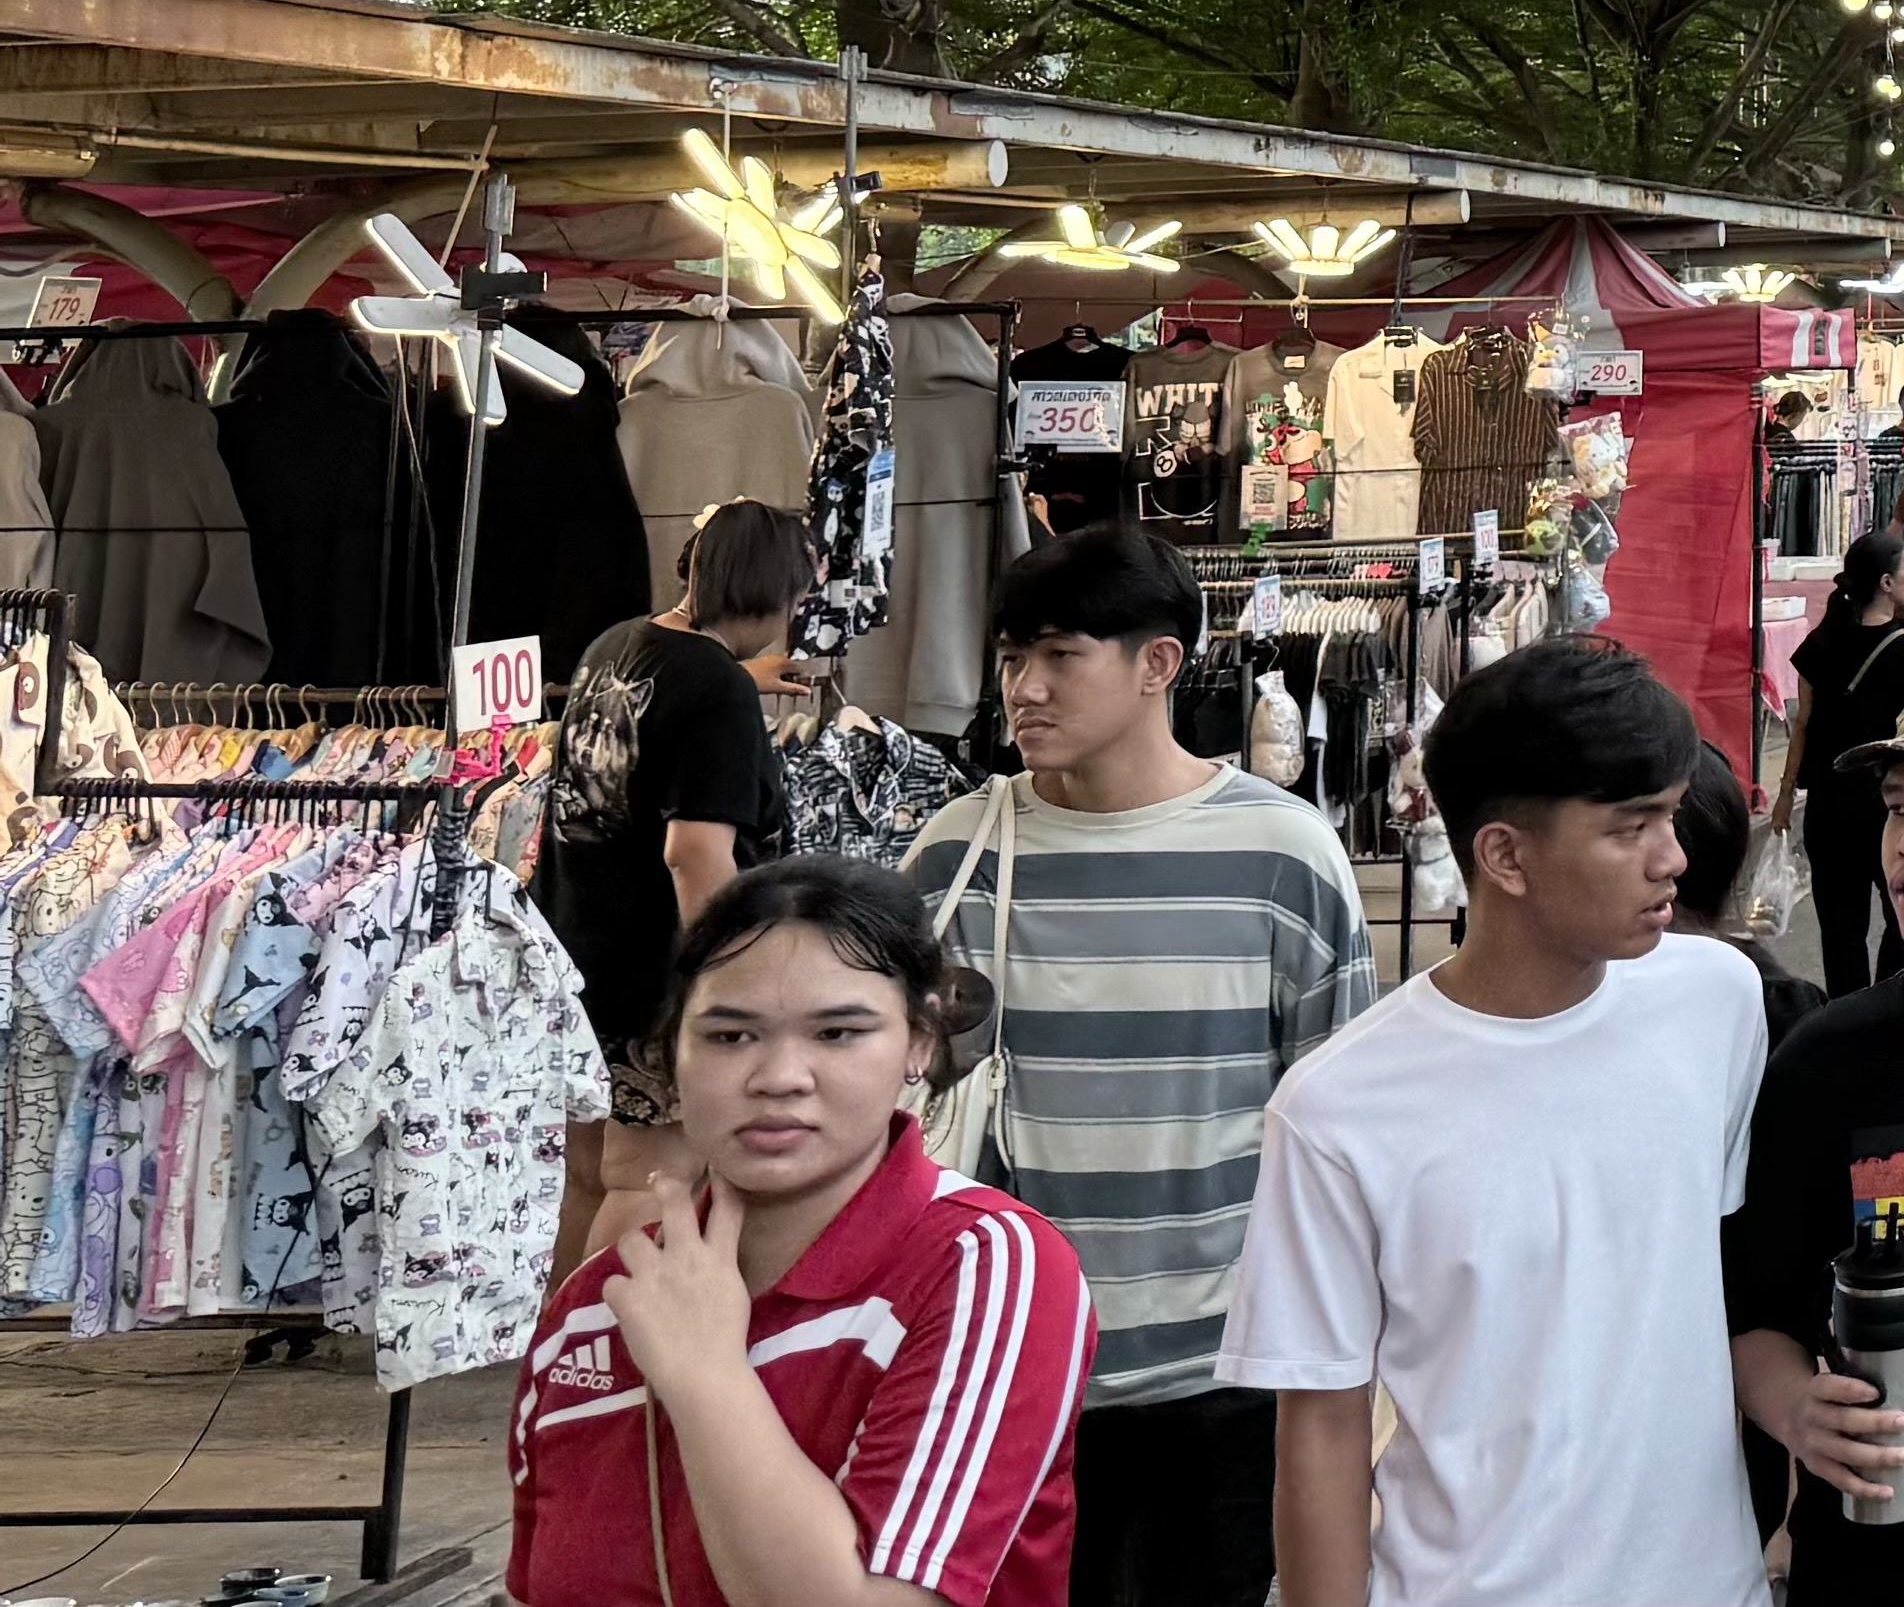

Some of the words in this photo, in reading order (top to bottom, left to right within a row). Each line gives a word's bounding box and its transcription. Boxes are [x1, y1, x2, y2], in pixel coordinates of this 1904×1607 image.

[48, 296, 81, 322] 179
[1590, 364, 1627, 382] 290
[472, 648, 534, 717] 100
[548, 1366, 615, 1391] adidas
